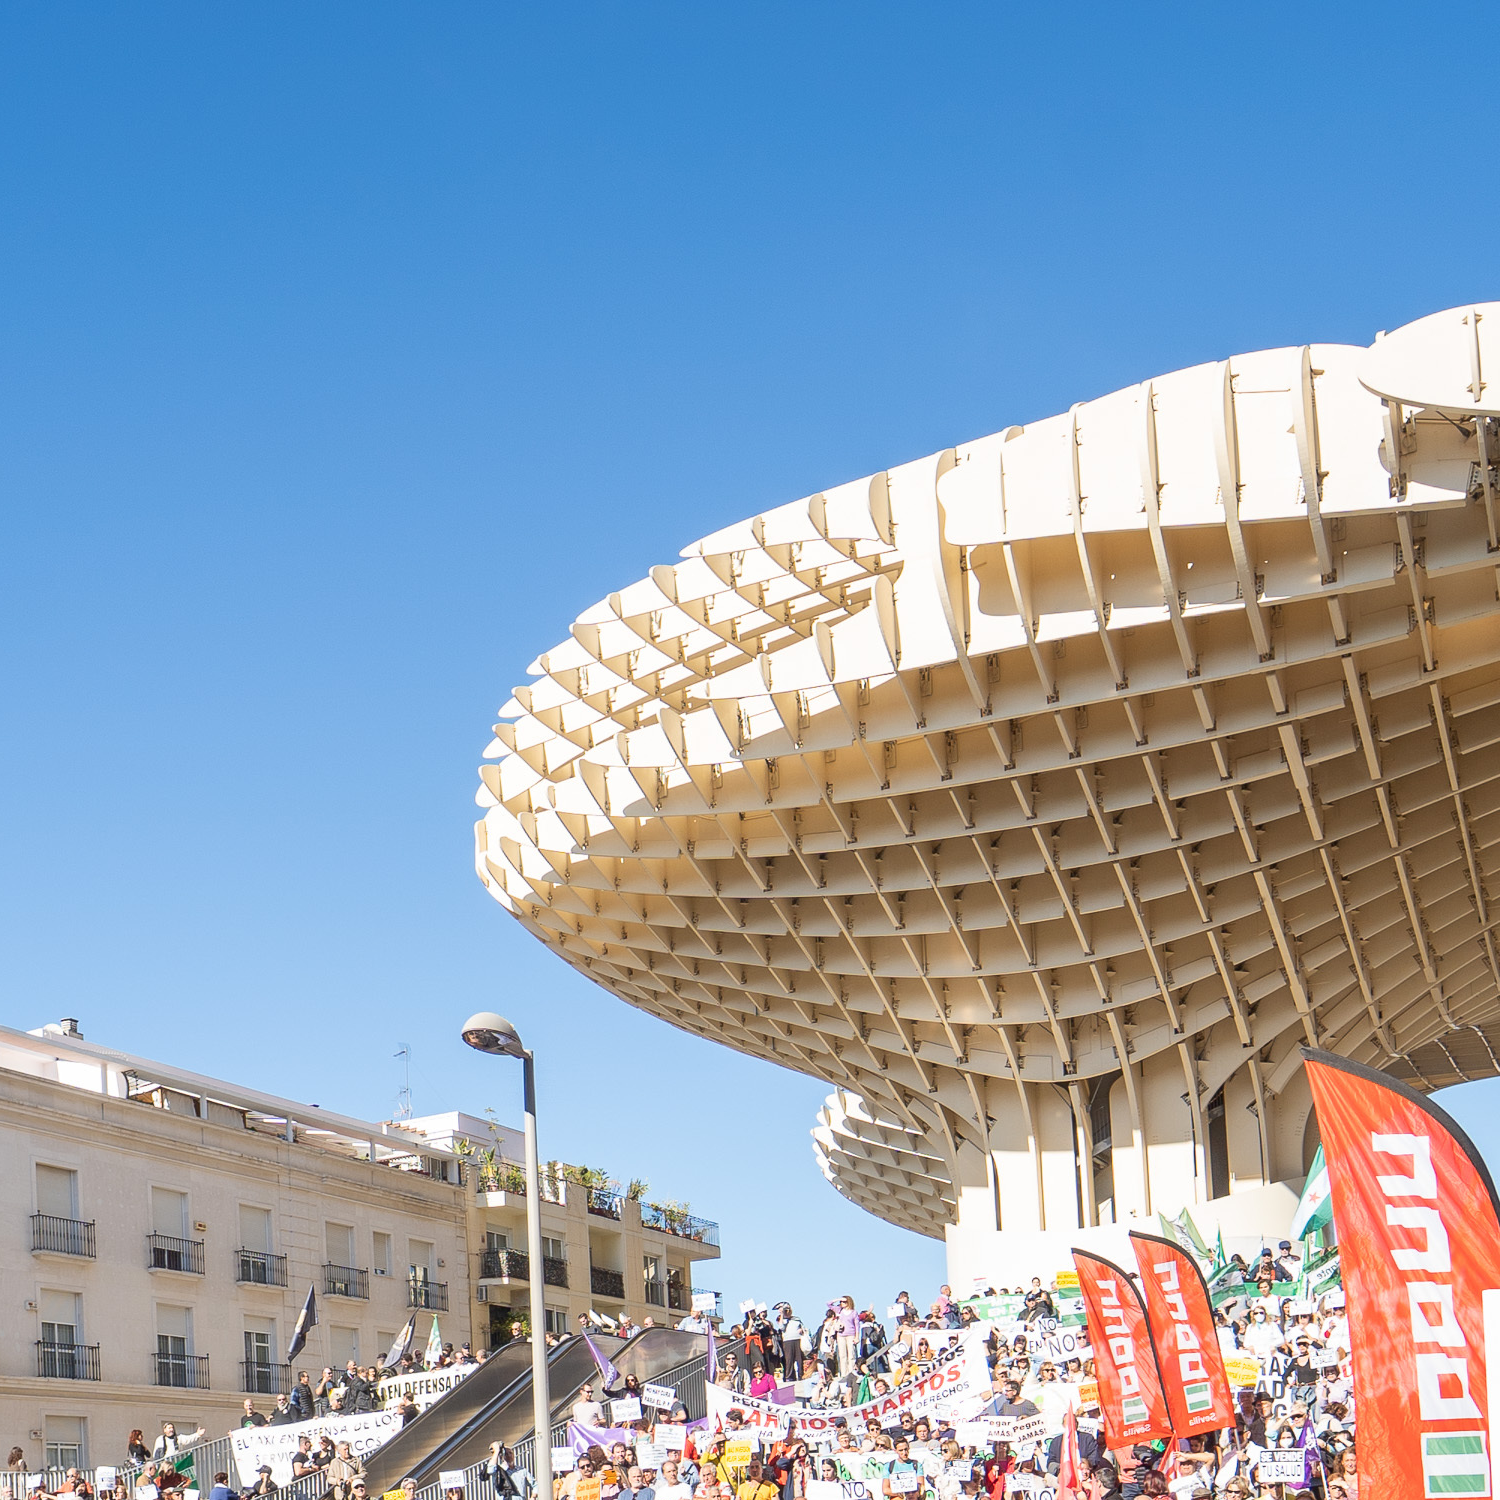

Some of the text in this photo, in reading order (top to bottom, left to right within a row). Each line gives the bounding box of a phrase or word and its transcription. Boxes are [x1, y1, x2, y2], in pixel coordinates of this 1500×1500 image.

[1038, 1318, 1057, 1331] NO
[1048, 1333, 1075, 1358] NO
[404, 1376, 452, 1397] DEFENSA
[915, 1380, 970, 1410] DERECHOS
[1260, 1450, 1303, 1462] SE VENDE
[1262, 1463, 1301, 1477] TU SALUD
[842, 1481, 865, 1499] NO
